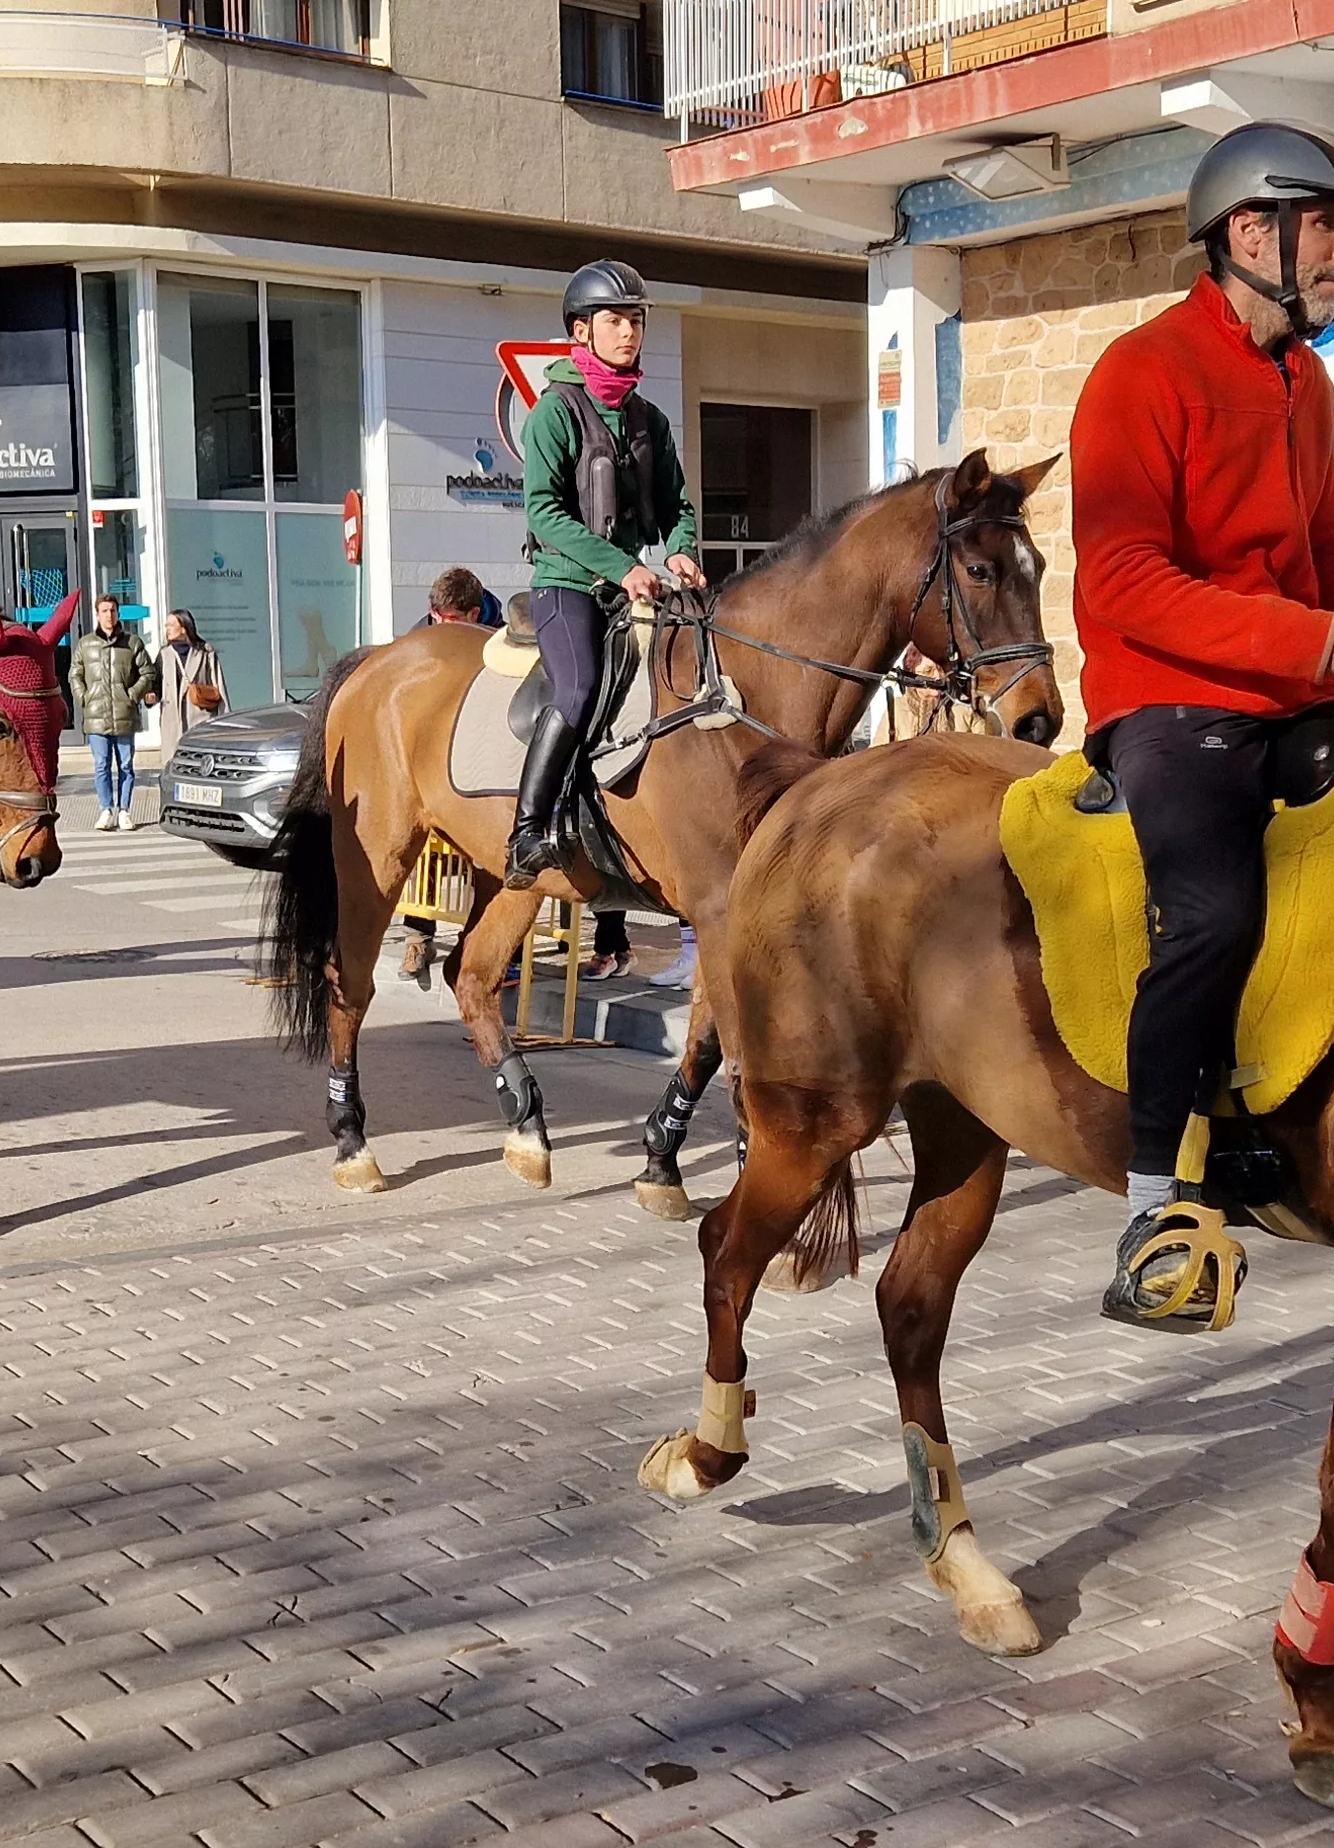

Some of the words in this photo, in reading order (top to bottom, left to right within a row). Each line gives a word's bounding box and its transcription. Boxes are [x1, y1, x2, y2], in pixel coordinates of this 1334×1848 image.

[0, 467, 56, 479] BIOMECÁNICA
[731, 515, 749, 538] 84
[196, 568, 243, 581] podoactiva
